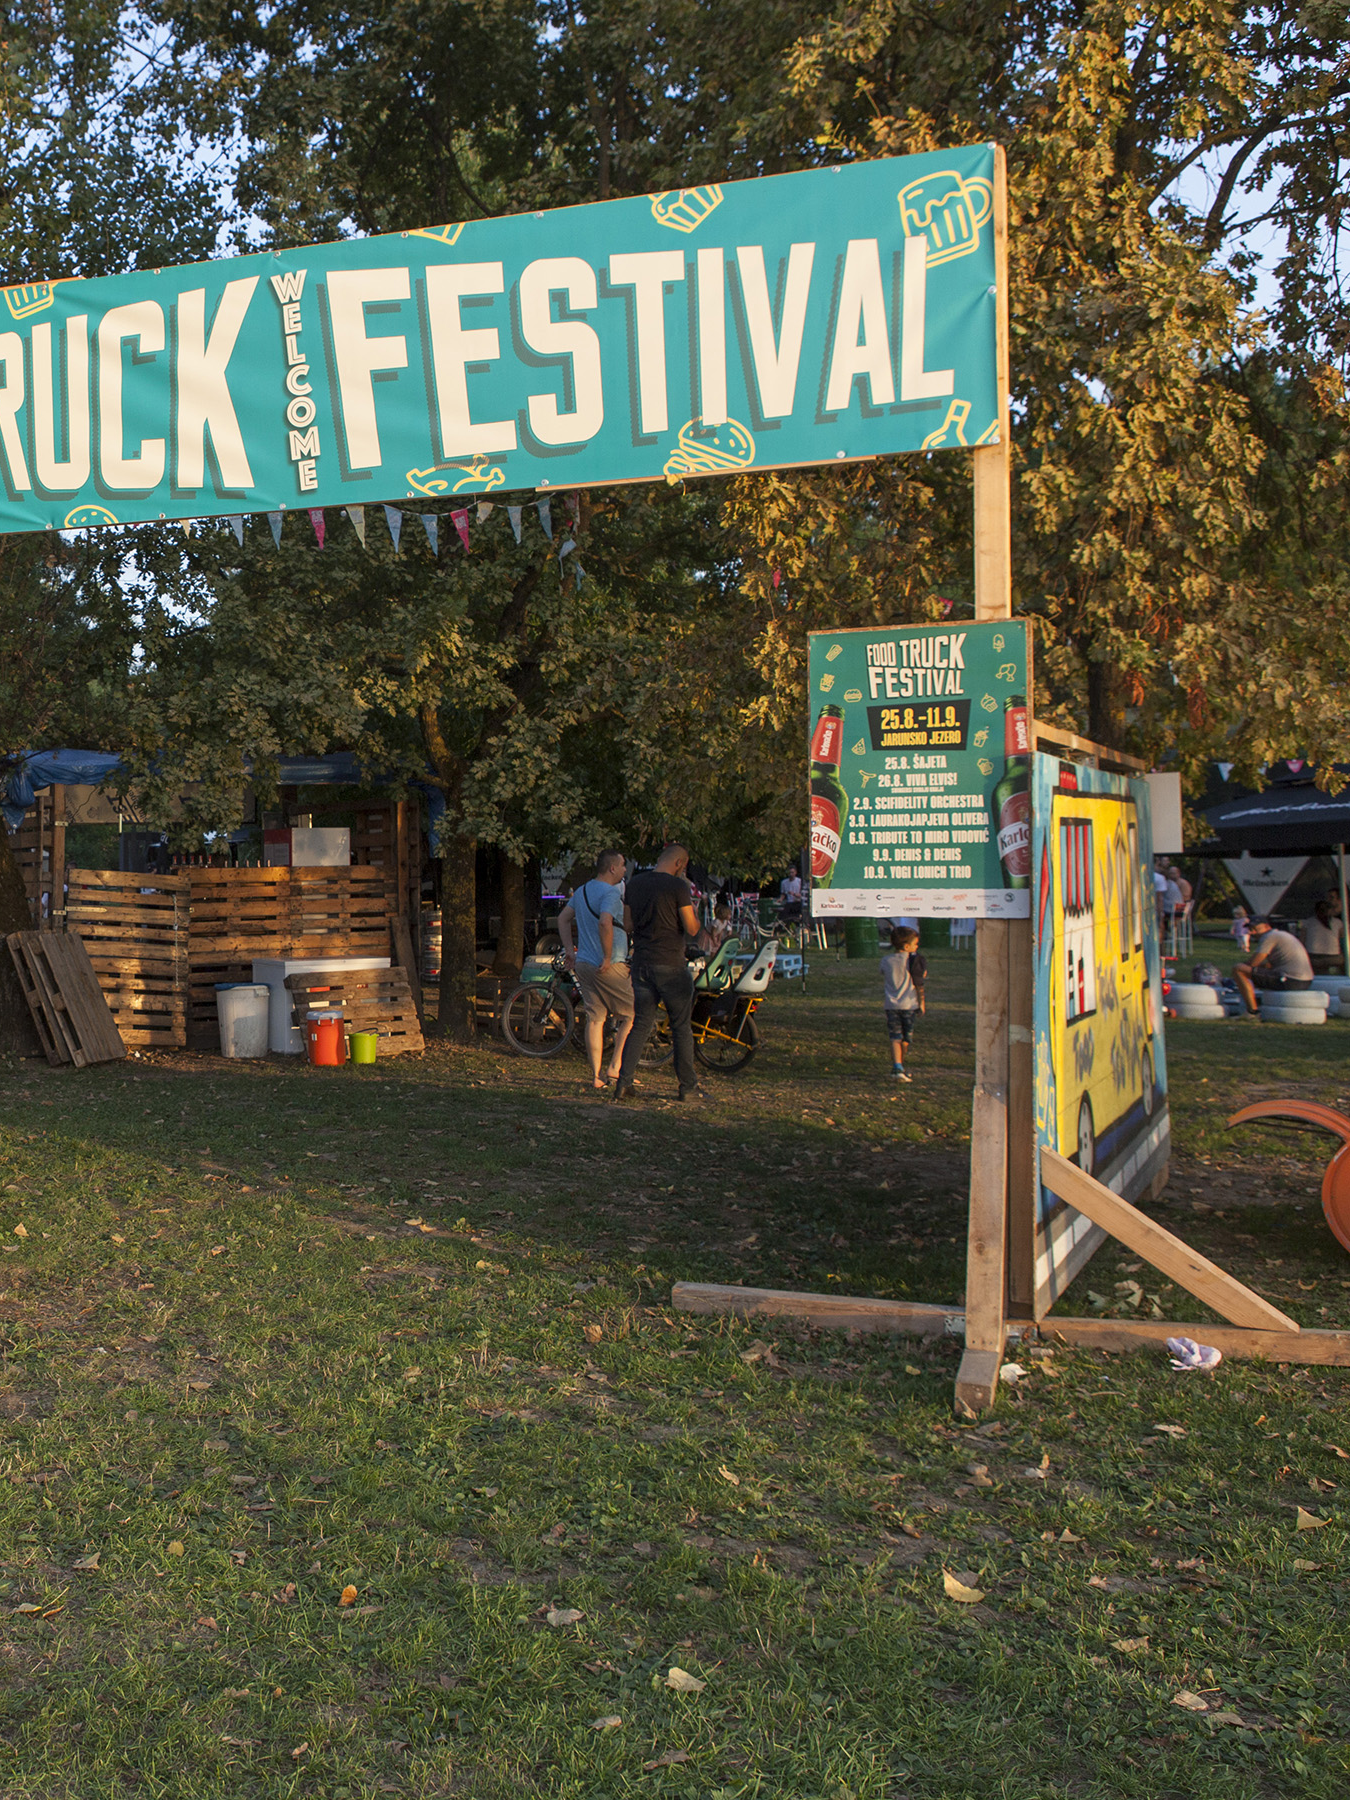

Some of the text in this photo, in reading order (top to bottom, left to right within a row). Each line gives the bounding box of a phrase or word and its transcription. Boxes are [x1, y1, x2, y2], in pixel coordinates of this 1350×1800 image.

[326, 235, 955, 470] FESTIVAL
[270, 268, 319, 493] WELCOME
[867, 633, 968, 669] FOOD TRUCK
[867, 666, 964, 699] FESTIVAL
[881, 706, 961, 730] 25.8.-11.9.
[881, 729, 962, 747] JARUNSKO JEZERO
[885, 752, 947, 770] 25.8. ŠAJETA
[878, 772, 958, 787] 26.8. VIVA ELVIS!
[853, 794, 985, 810] 2.9. SCIFIDELITY ORCHESTRA
[849, 814, 869, 828] 3.9.
[951, 812, 989, 826] OLIVERA
[811, 831, 838, 855] ačko
[849, 826, 990, 845] 6.9. TRIBUTE TO MIRO VIDOVIĆ
[872, 849, 893, 862] 9.9.
[894, 848, 922, 862] DENIS
[934, 847, 962, 861] DENIS
[863, 866, 888, 879] 10.9.
[890, 866, 912, 879] YOGI
[949, 865, 972, 879] TRIO
